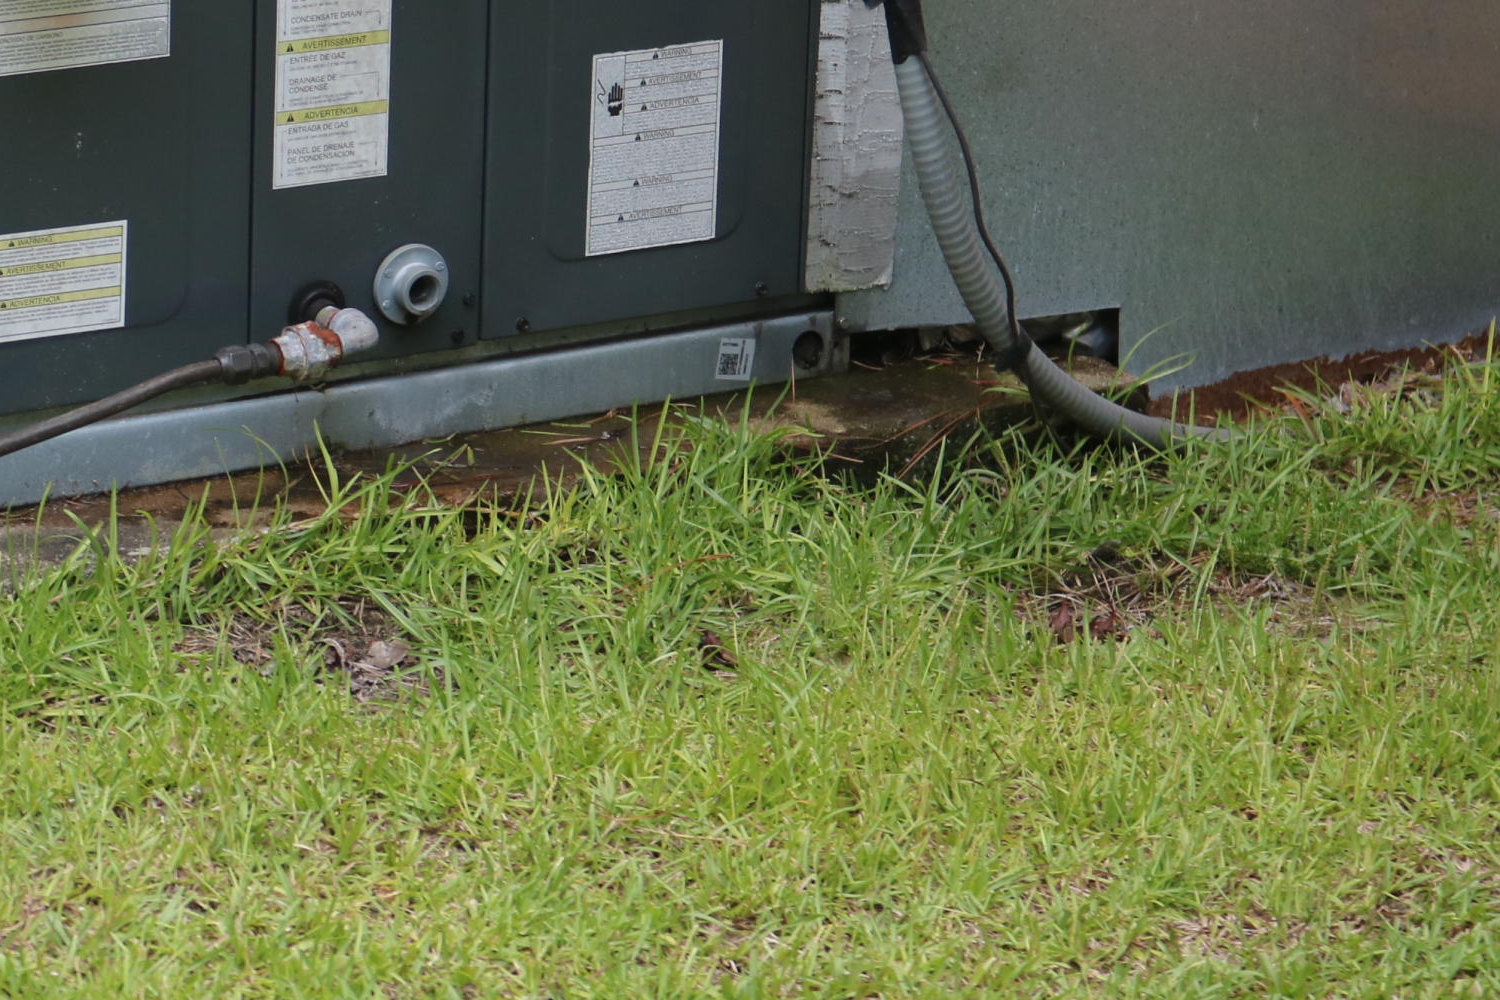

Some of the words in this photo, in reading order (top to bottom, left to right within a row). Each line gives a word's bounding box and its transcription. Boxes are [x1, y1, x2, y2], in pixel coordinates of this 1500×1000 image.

[290, 12, 338, 24] CONDENSATE
[340, 10, 362, 18] DRAIN
[302, 35, 367, 50] AVERTISSEMENT
[304, 106, 359, 120] ADVERTENCIA
